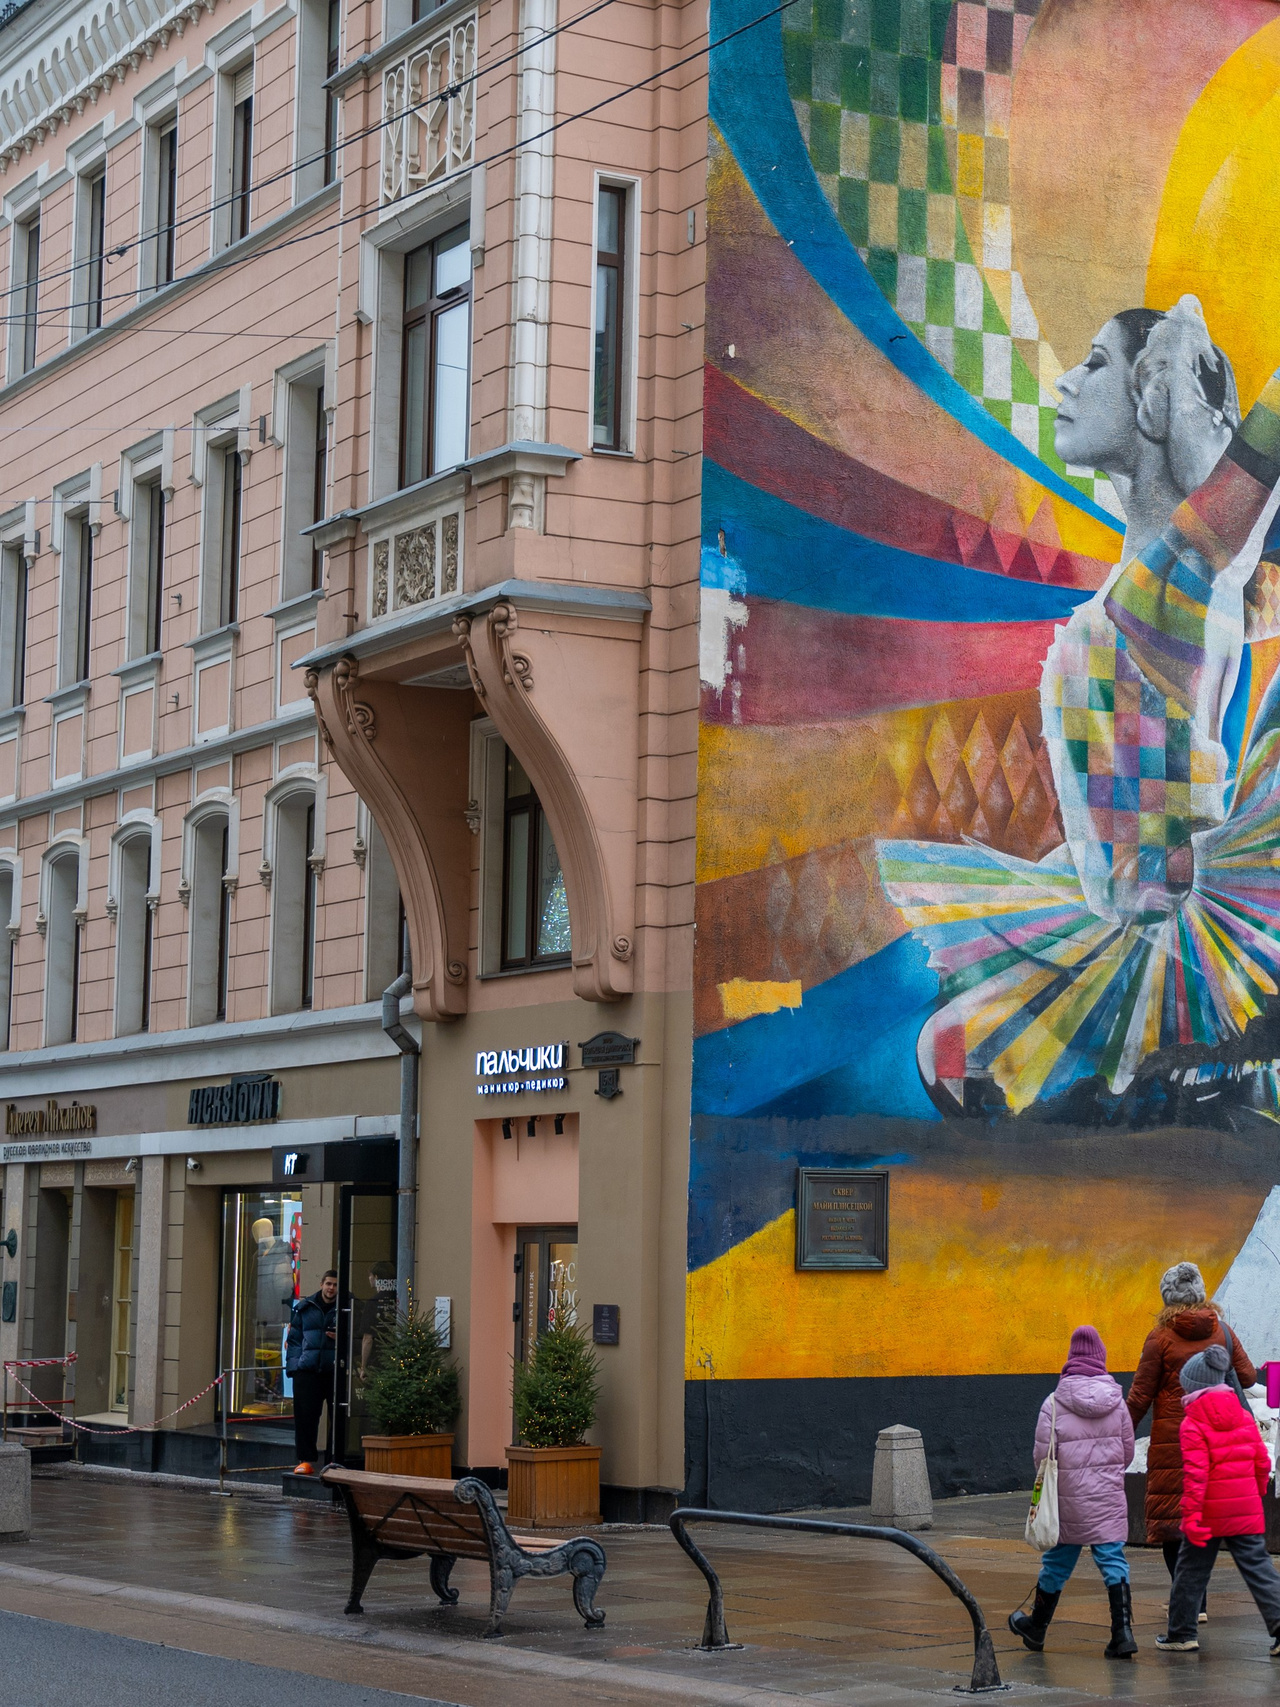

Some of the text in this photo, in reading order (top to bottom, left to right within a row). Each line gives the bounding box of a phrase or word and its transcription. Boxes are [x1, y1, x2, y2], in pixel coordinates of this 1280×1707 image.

[476, 1044, 563, 1076] пальчики
[187, 1073, 280, 1124] KICKSTOWN
[832, 1187, 854, 1197] СКВЕР
